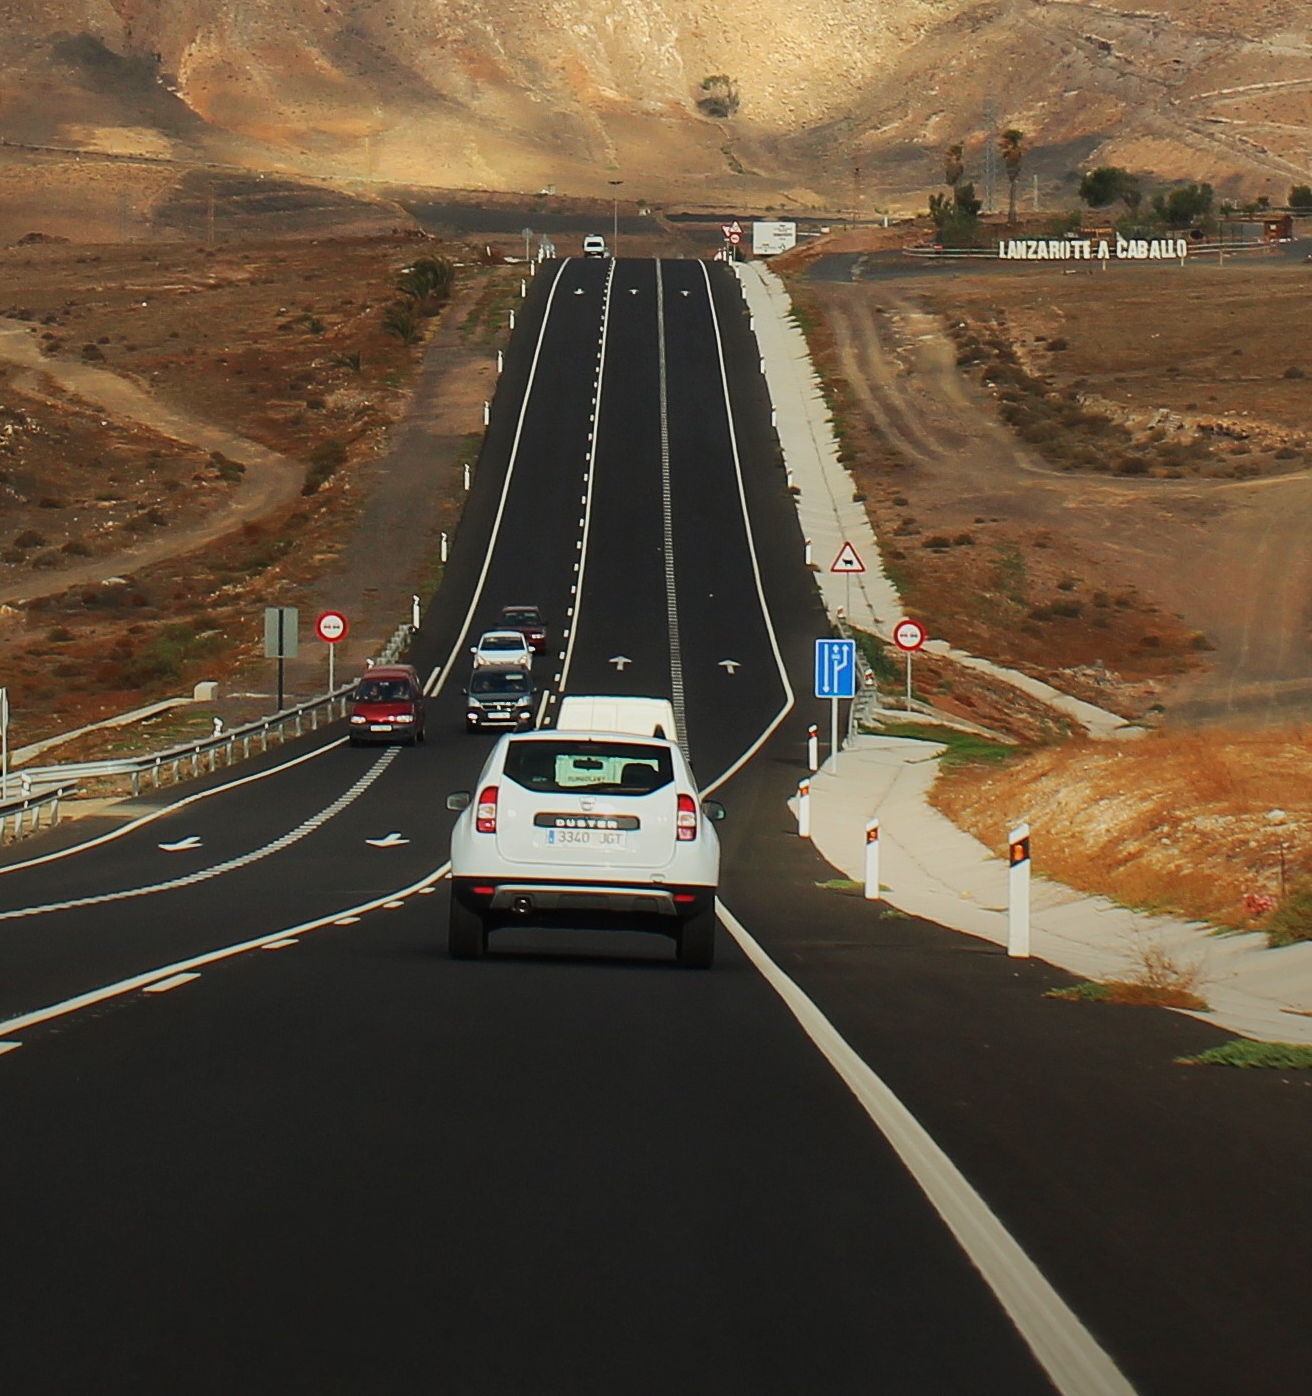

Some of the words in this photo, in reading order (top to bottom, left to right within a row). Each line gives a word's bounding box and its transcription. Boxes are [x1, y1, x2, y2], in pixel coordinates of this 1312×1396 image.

[998, 240, 1090, 259] LANZAROTE
[1097, 240, 1109, 259] A
[1116, 239, 1187, 259] CABALLO
[555, 818, 618, 829] DUSTER
[558, 831, 589, 843] 3340
[599, 833, 623, 844] JGT
